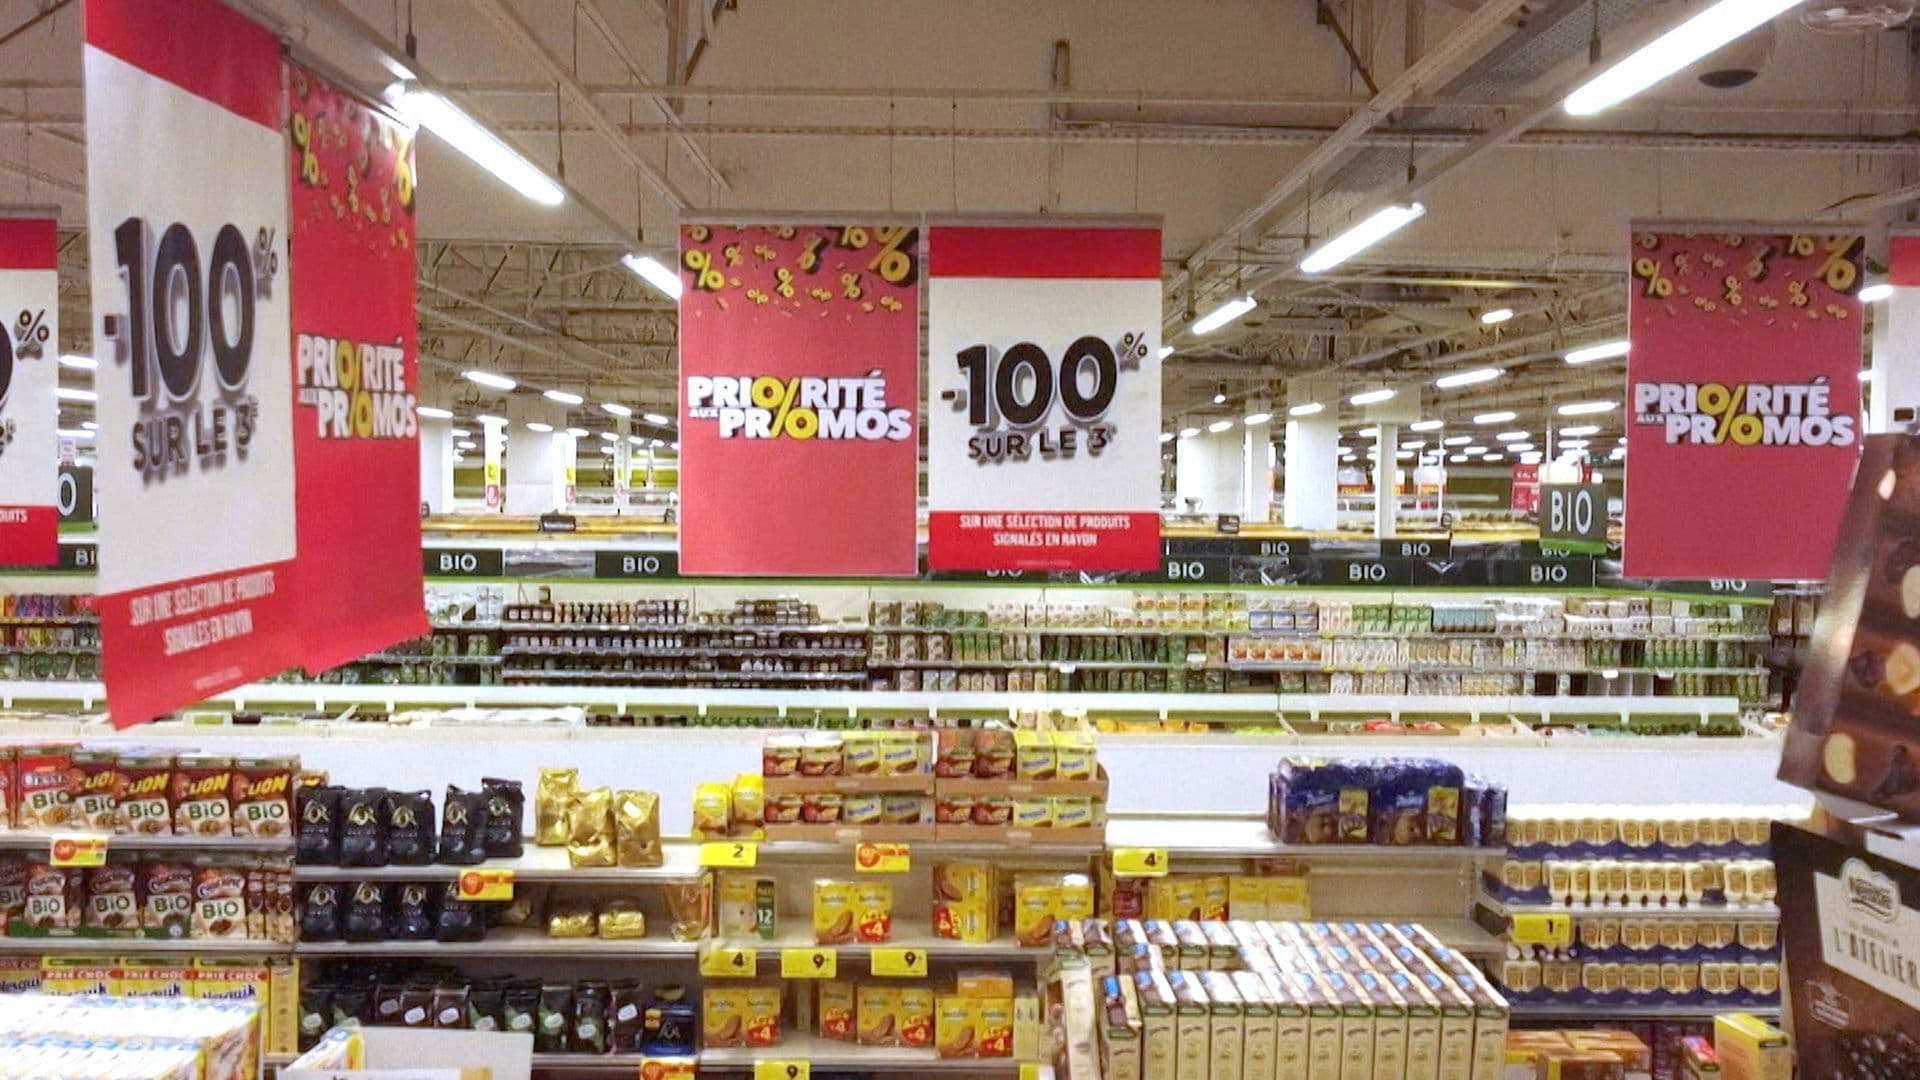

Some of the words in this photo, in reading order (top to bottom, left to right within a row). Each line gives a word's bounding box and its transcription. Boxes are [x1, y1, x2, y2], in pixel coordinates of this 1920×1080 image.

[942, 331, 1148, 425] -100%
[133, 417, 185, 471] SUR
[195, 407, 228, 454] LE
[968, 434, 1024, 459] SUR
[1040, 430, 1077, 452] LE
[1551, 489, 1592, 534] BIO
[75, 549, 96, 566] BI
[1261, 541, 1290, 556] BIO
[1402, 542, 1431, 557] BIO
[440, 554, 478, 571] BIO
[623, 556, 660, 573] BIO
[1168, 561, 1205, 579] BIO
[1350, 563, 1386, 581] BIO
[1531, 565, 1568, 583] BIO
[1710, 579, 1747, 592] BIO
[190, 773, 230, 795] LION
[248, 774, 290, 795] LION
